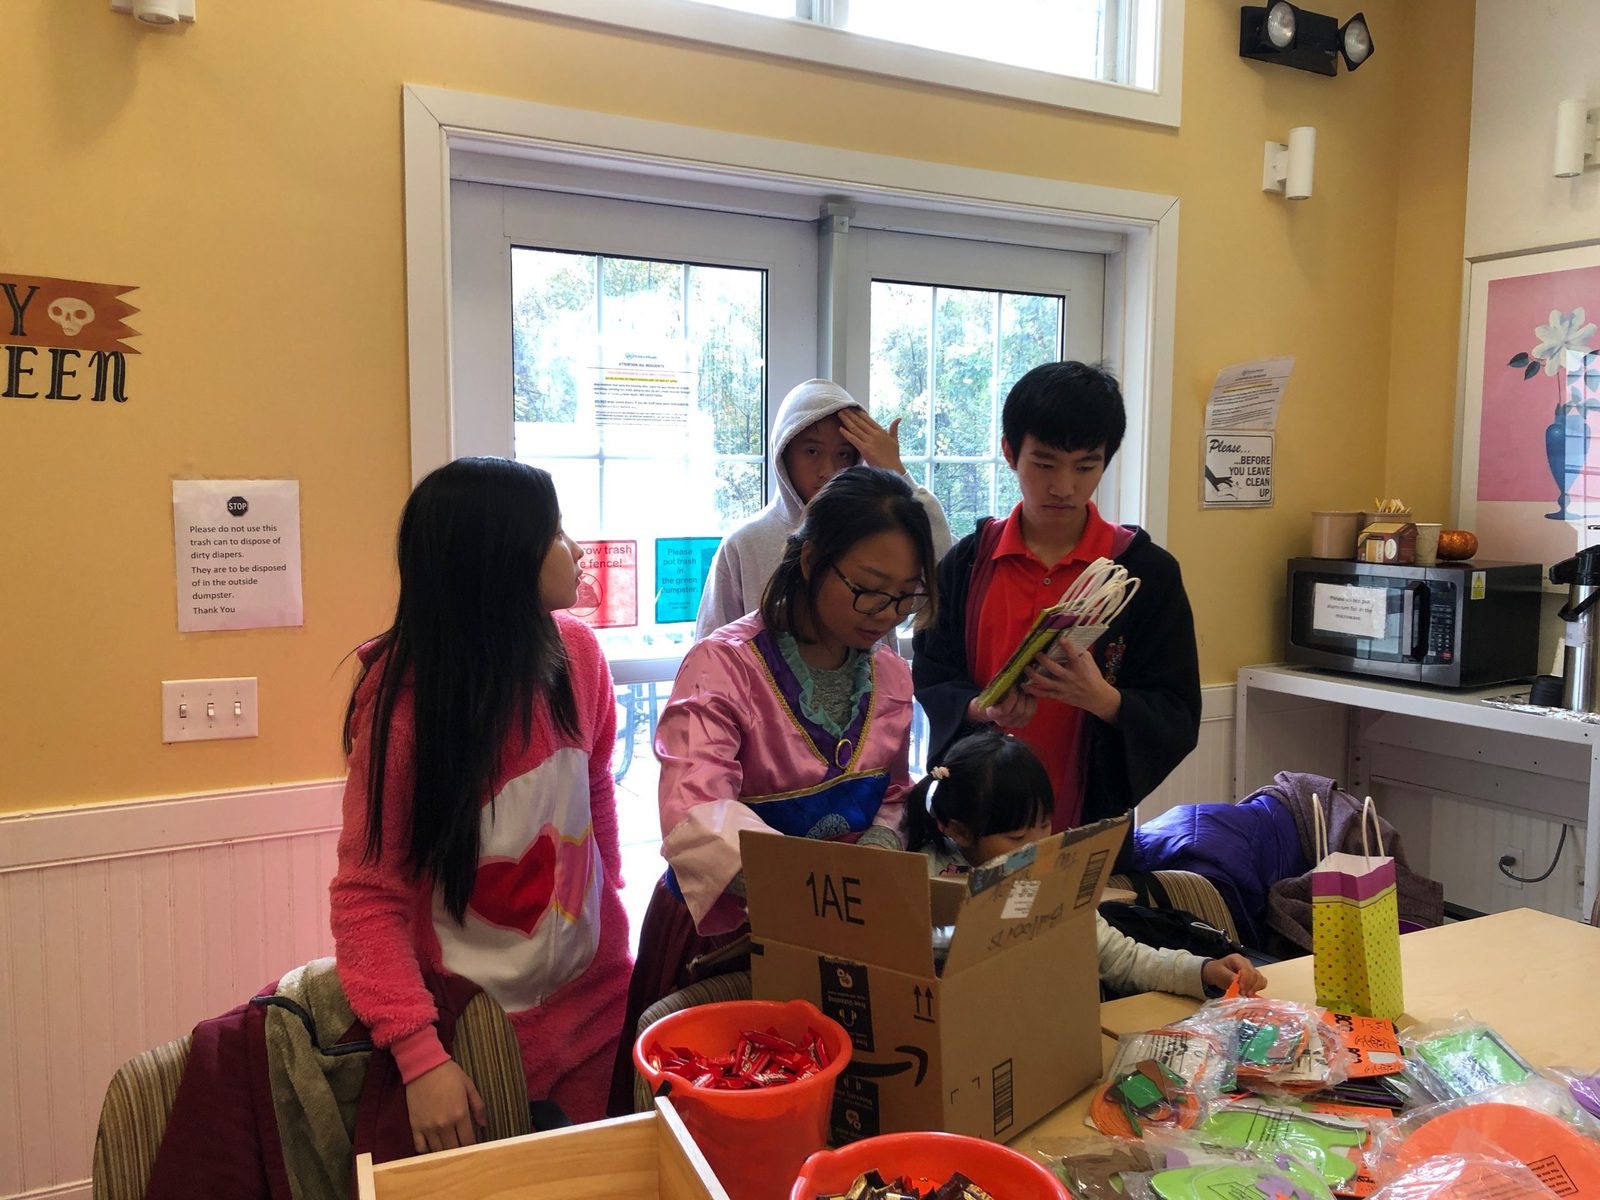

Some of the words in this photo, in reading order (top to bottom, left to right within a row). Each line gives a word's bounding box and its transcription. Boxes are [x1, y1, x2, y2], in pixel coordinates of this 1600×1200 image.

[0, 283, 40, 336] Y
[0, 345, 128, 403] EEN
[1229, 466, 1245, 476] YOU
[1248, 467, 1270, 476] LEAVE
[1246, 478, 1270, 486] CLEAN
[1260, 488, 1270, 498] UP
[228, 502, 246, 510] STOP
[241, 538, 270, 547] dispose
[604, 544, 632, 554] trash
[191, 552, 210, 560] dirty
[212, 552, 244, 560] diapers.
[589, 558, 622, 568] fence!
[192, 566, 212, 574] They
[252, 564, 286, 573] disposed
[228, 578, 258, 586] outside
[192, 592, 234, 601] dumpster.
[193, 606, 218, 614] Thank
[806, 872, 865, 925] 1AE
